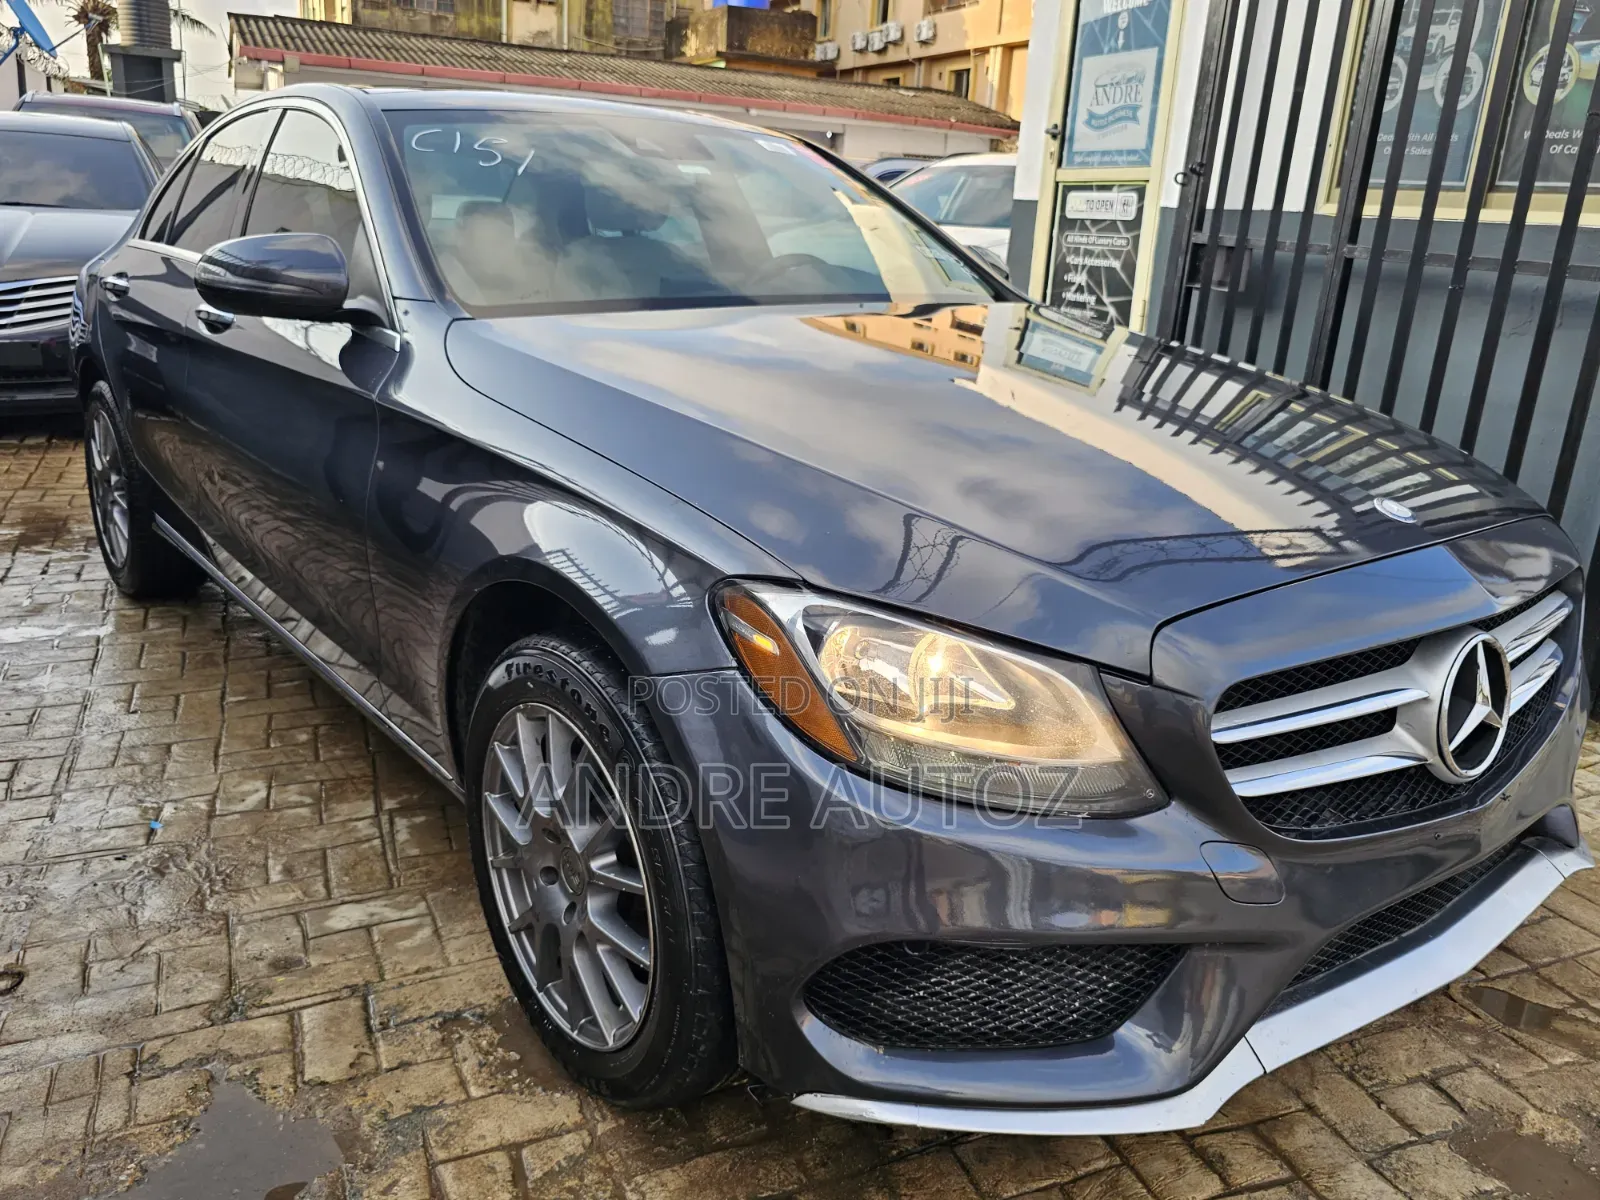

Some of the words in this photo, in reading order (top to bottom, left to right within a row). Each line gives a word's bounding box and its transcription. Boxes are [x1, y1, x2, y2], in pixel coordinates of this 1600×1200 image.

[1090, 83, 1144, 107] ANDRE
[1421, 132, 1434, 141] All
[1410, 146, 1432, 156] Sales
[1549, 144, 1563, 154] Of
[1086, 199, 1095, 210] TO
[1095, 199, 1114, 211] OPEN
[1066, 292, 1097, 305] Marketing
